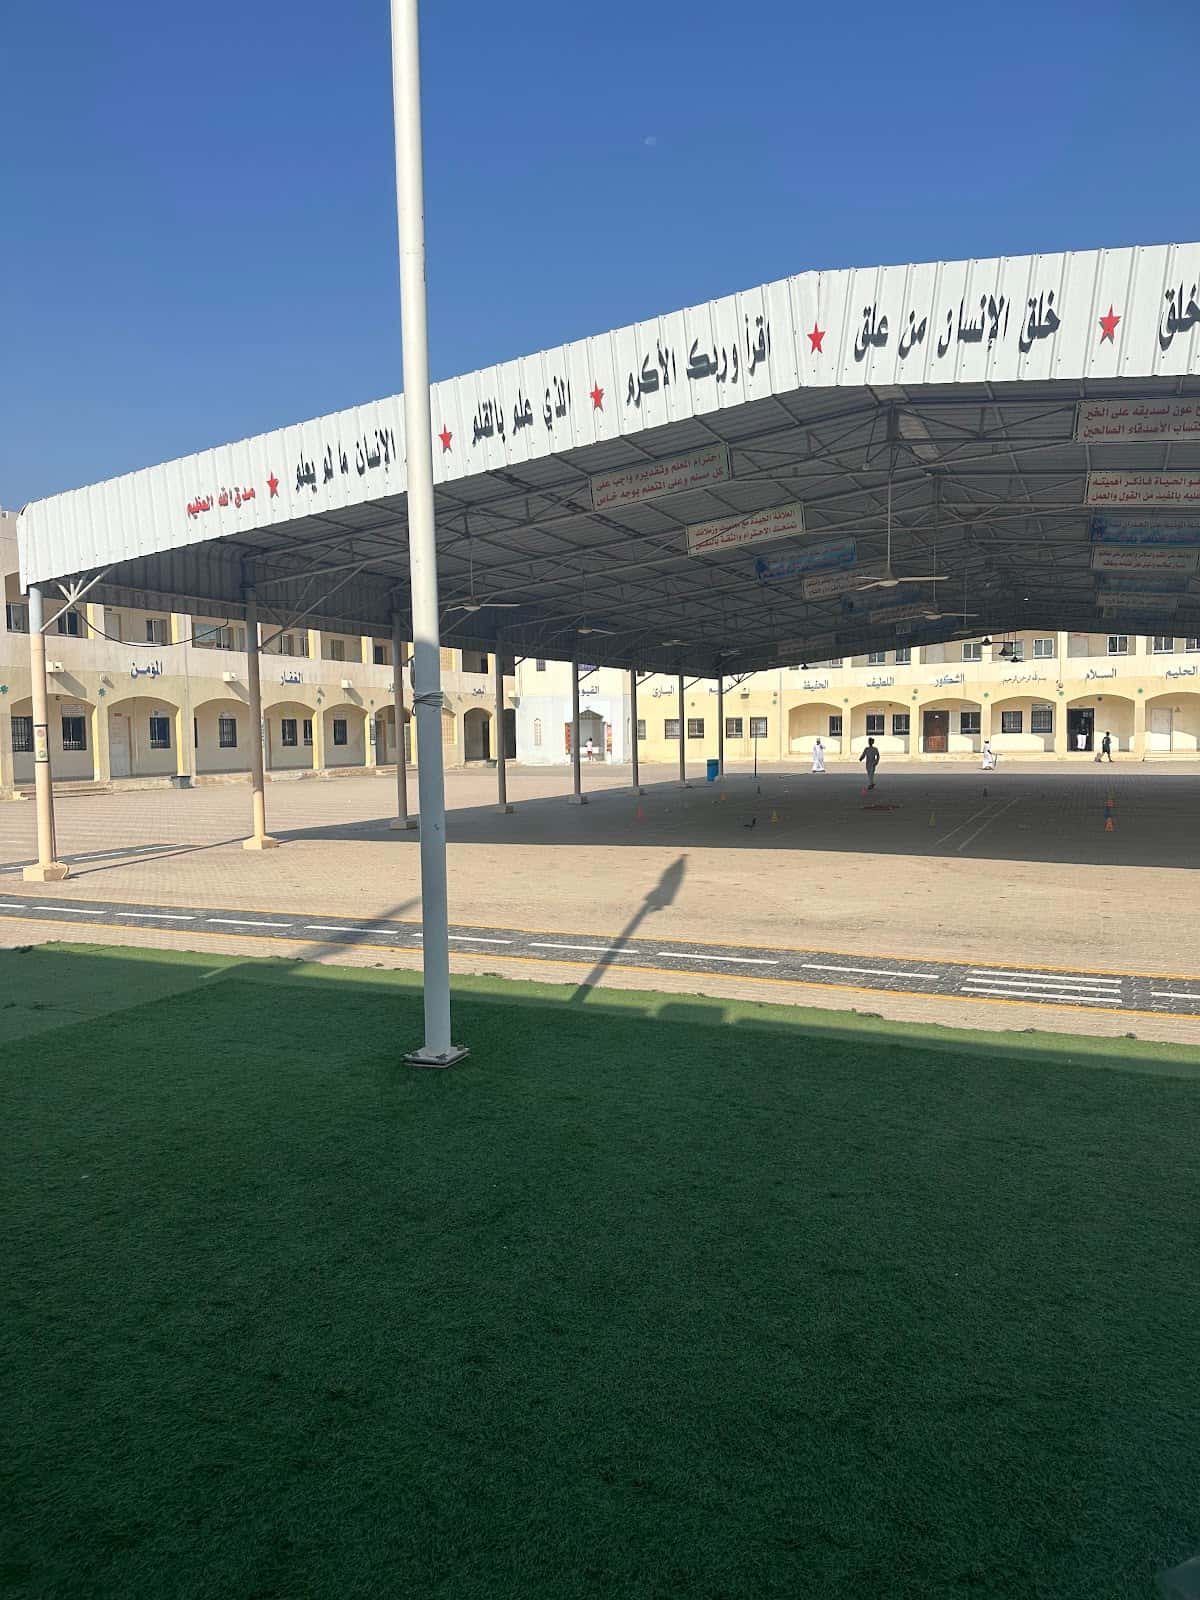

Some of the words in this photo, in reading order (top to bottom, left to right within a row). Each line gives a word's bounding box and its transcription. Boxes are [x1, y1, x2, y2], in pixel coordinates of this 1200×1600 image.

[854, 302, 889, 362] علق
[898, 310, 927, 360] من
[937, 293, 1011, 358] الإنسان
[1018, 289, 1061, 354] خلق
[626, 338, 677, 408] الأكرم
[686, 337, 739, 385] وربك
[472, 396, 506, 447] بالقلم
[513, 388, 534, 436] علم
[543, 375, 571, 432] الذي
[296, 450, 318, 493] يعلم
[323, 442, 334, 484] لم
[338, 440, 349, 475] ما
[355, 427, 397, 477] الإنسان
[187, 494, 214, 519] العظيم
[218, 486, 233, 507] الله
[234, 487, 256, 508] صدق
[130, 660, 163, 679] المؤمن
[579, 684, 600, 697] القيو
[802, 679, 829, 692] الحفيظ
[866, 676, 895, 689] اللطيف
[934, 672, 965, 688] الشكور
[1085, 667, 1117, 680] السلام
[1165, 665, 1199, 681] الحليم
